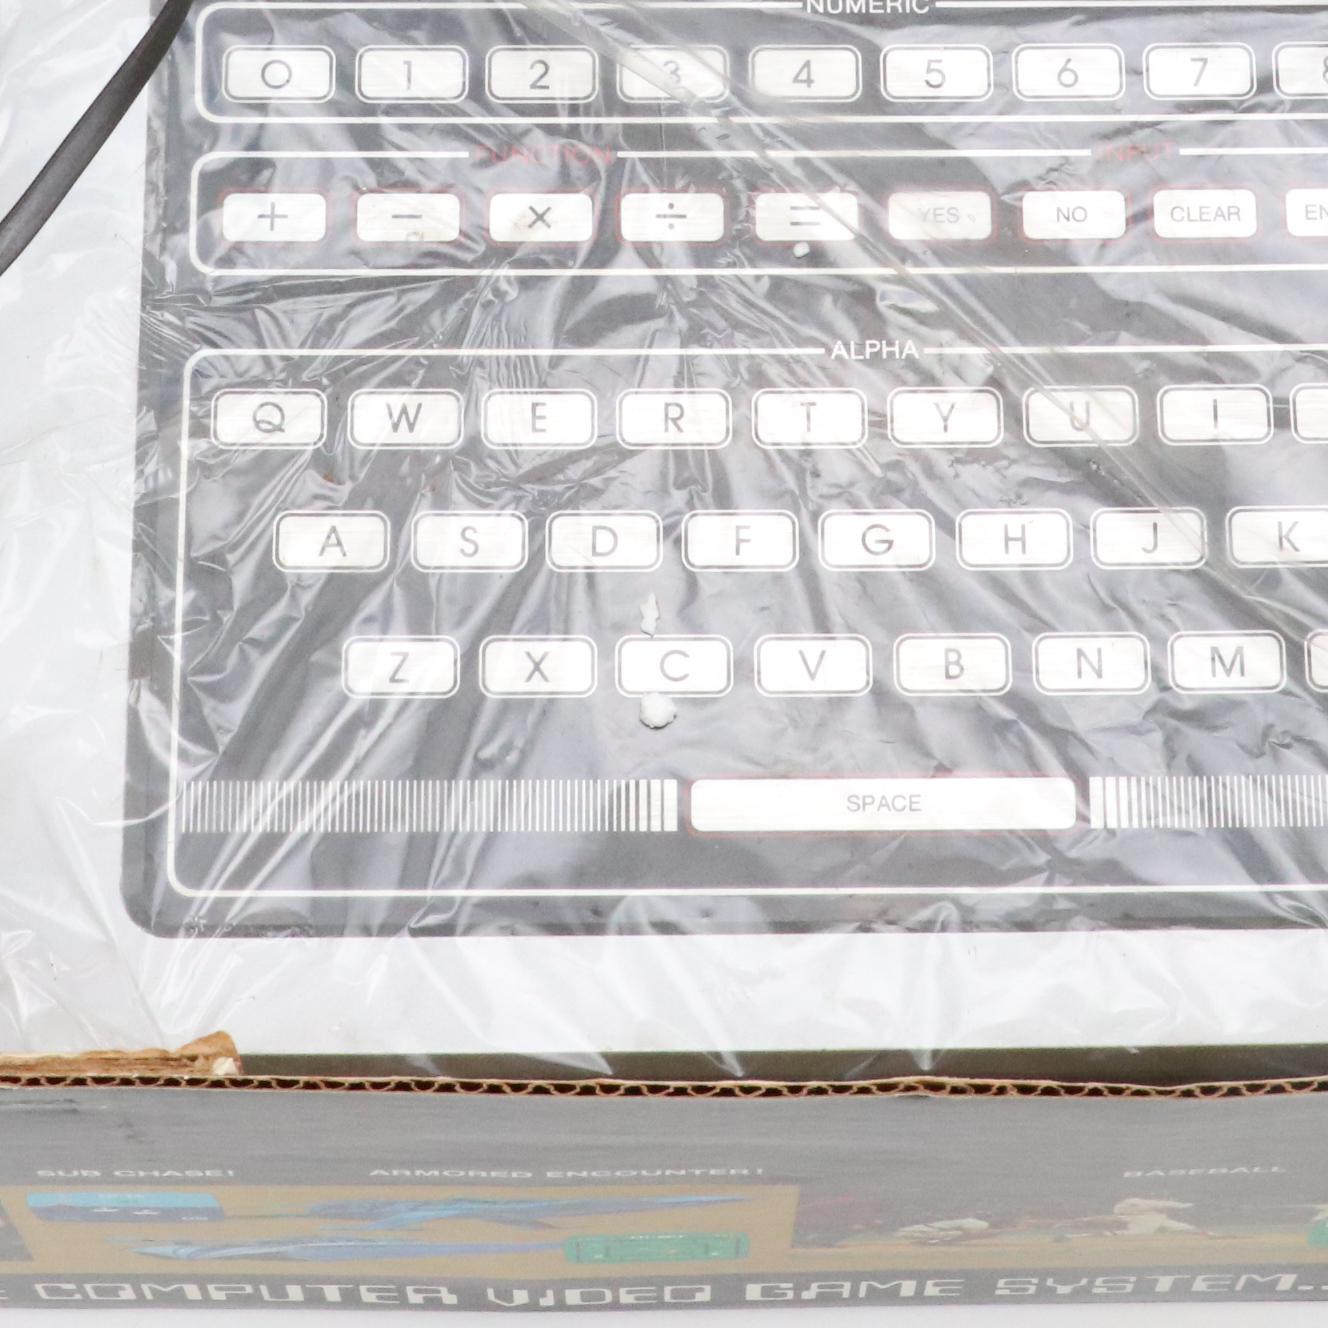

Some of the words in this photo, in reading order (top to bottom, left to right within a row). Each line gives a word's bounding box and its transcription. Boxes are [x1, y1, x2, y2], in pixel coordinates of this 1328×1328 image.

[404, 61, 411, 90] 1
[530, 60, 549, 89] 2
[662, 59, 681, 88] 3
[793, 60, 814, 88] 4
[925, 60, 943, 88] 5
[1058, 58, 1078, 88] 6
[1191, 58, 1208, 86] 7
[1057, 206, 1087, 222] NO
[1170, 206, 1240, 222] CLEAR
[831, 340, 920, 361] ALPHA
[253, 402, 285, 433] Q
[387, 403, 422, 433] W
[532, 402, 545, 432] E
[665, 403, 684, 432] R
[800, 402, 816, 432] T
[935, 403, 954, 432] Y
[1070, 401, 1089, 432] U
[320, 526, 346, 557] A
[460, 526, 479, 557] S
[592, 526, 617, 556] D
[736, 526, 750, 556] F
[862, 524, 894, 555] G
[1005, 525, 1026, 554] H
[1144, 522, 1157, 553] J
[1279, 522, 1300, 552] K
[389, 654, 408, 683] Z
[526, 652, 549, 682] X
[660, 650, 689, 682] C
[799, 650, 826, 680] V
[945, 649, 964, 680] B
[1077, 648, 1102, 679] N
[1211, 647, 1244, 676] M
[847, 795, 921, 812] SPACE
[37, 1168, 106, 1180] SUB
[114, 1168, 236, 1180] CHASE!
[369, 1168, 533, 1181] ARMORED
[547, 1167, 766, 1181] ENCOUNTER!
[1124, 1166, 1288, 1178] BASEBALL
[32, 1282, 459, 1306] COMPUTER
[487, 1283, 715, 1307] VIDEO
[746, 1277, 964, 1301] GAME
